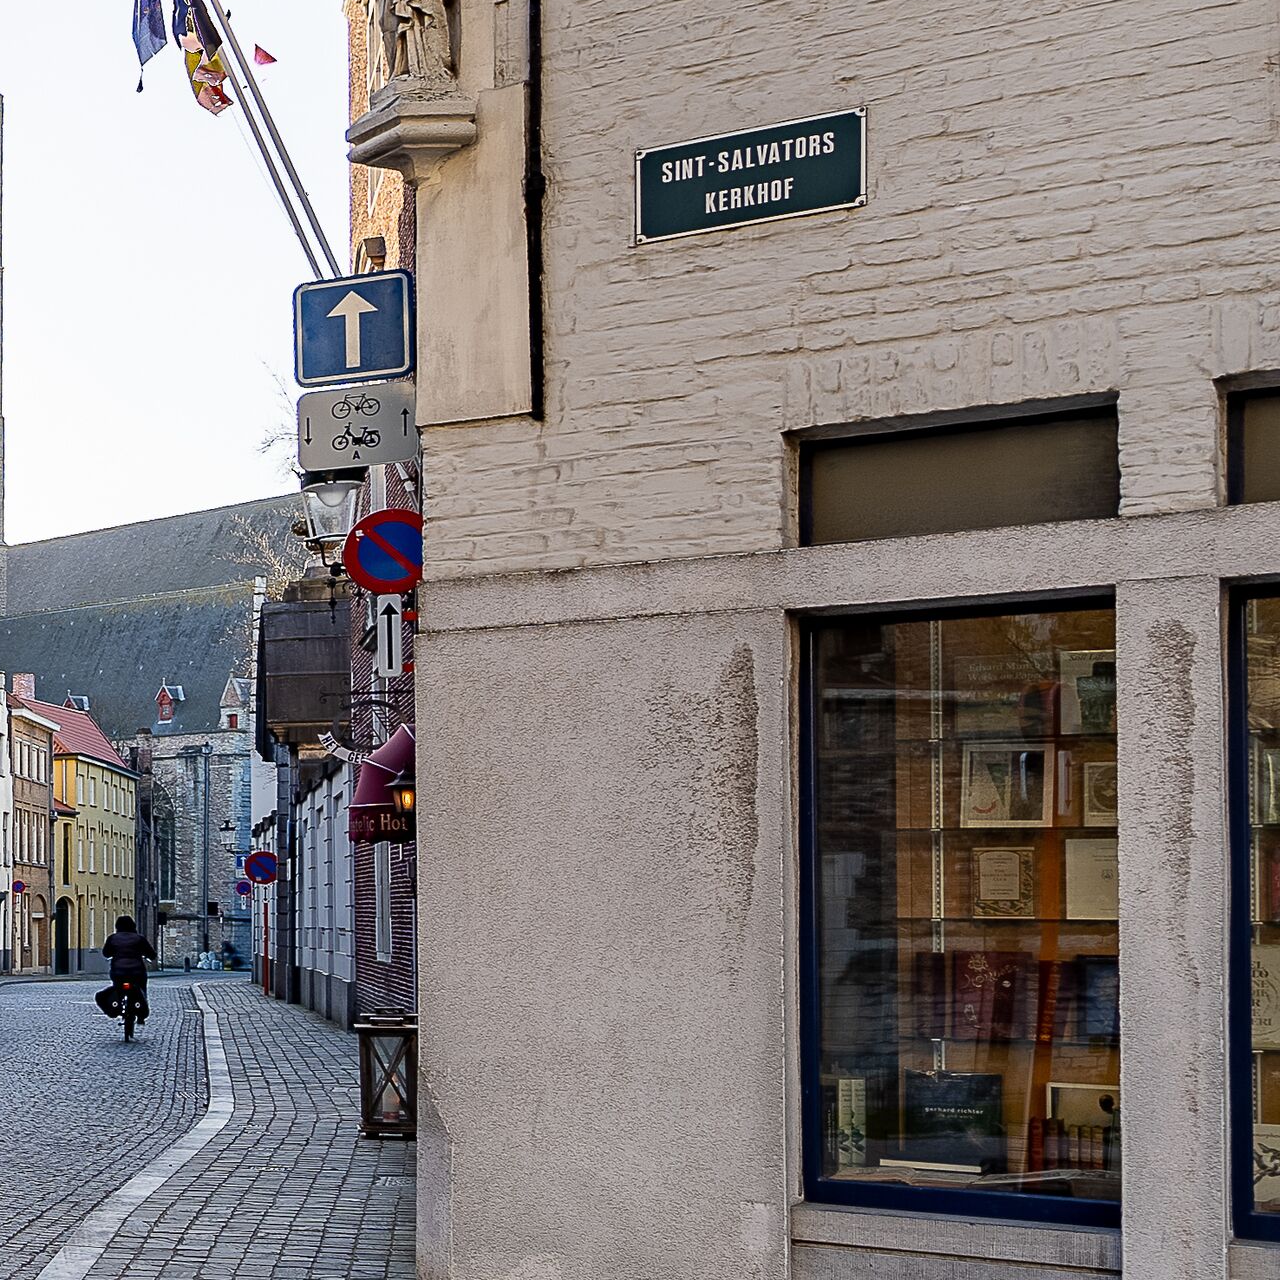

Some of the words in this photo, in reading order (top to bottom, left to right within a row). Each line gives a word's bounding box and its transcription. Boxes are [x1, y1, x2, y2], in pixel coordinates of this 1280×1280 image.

[661, 132, 835, 183] SINT-SALVATORS
[705, 177, 794, 214] KERKHOF
[352, 450, 360, 460] A
[321, 735, 342, 753] HET
[957, 1107, 984, 1115] richter
